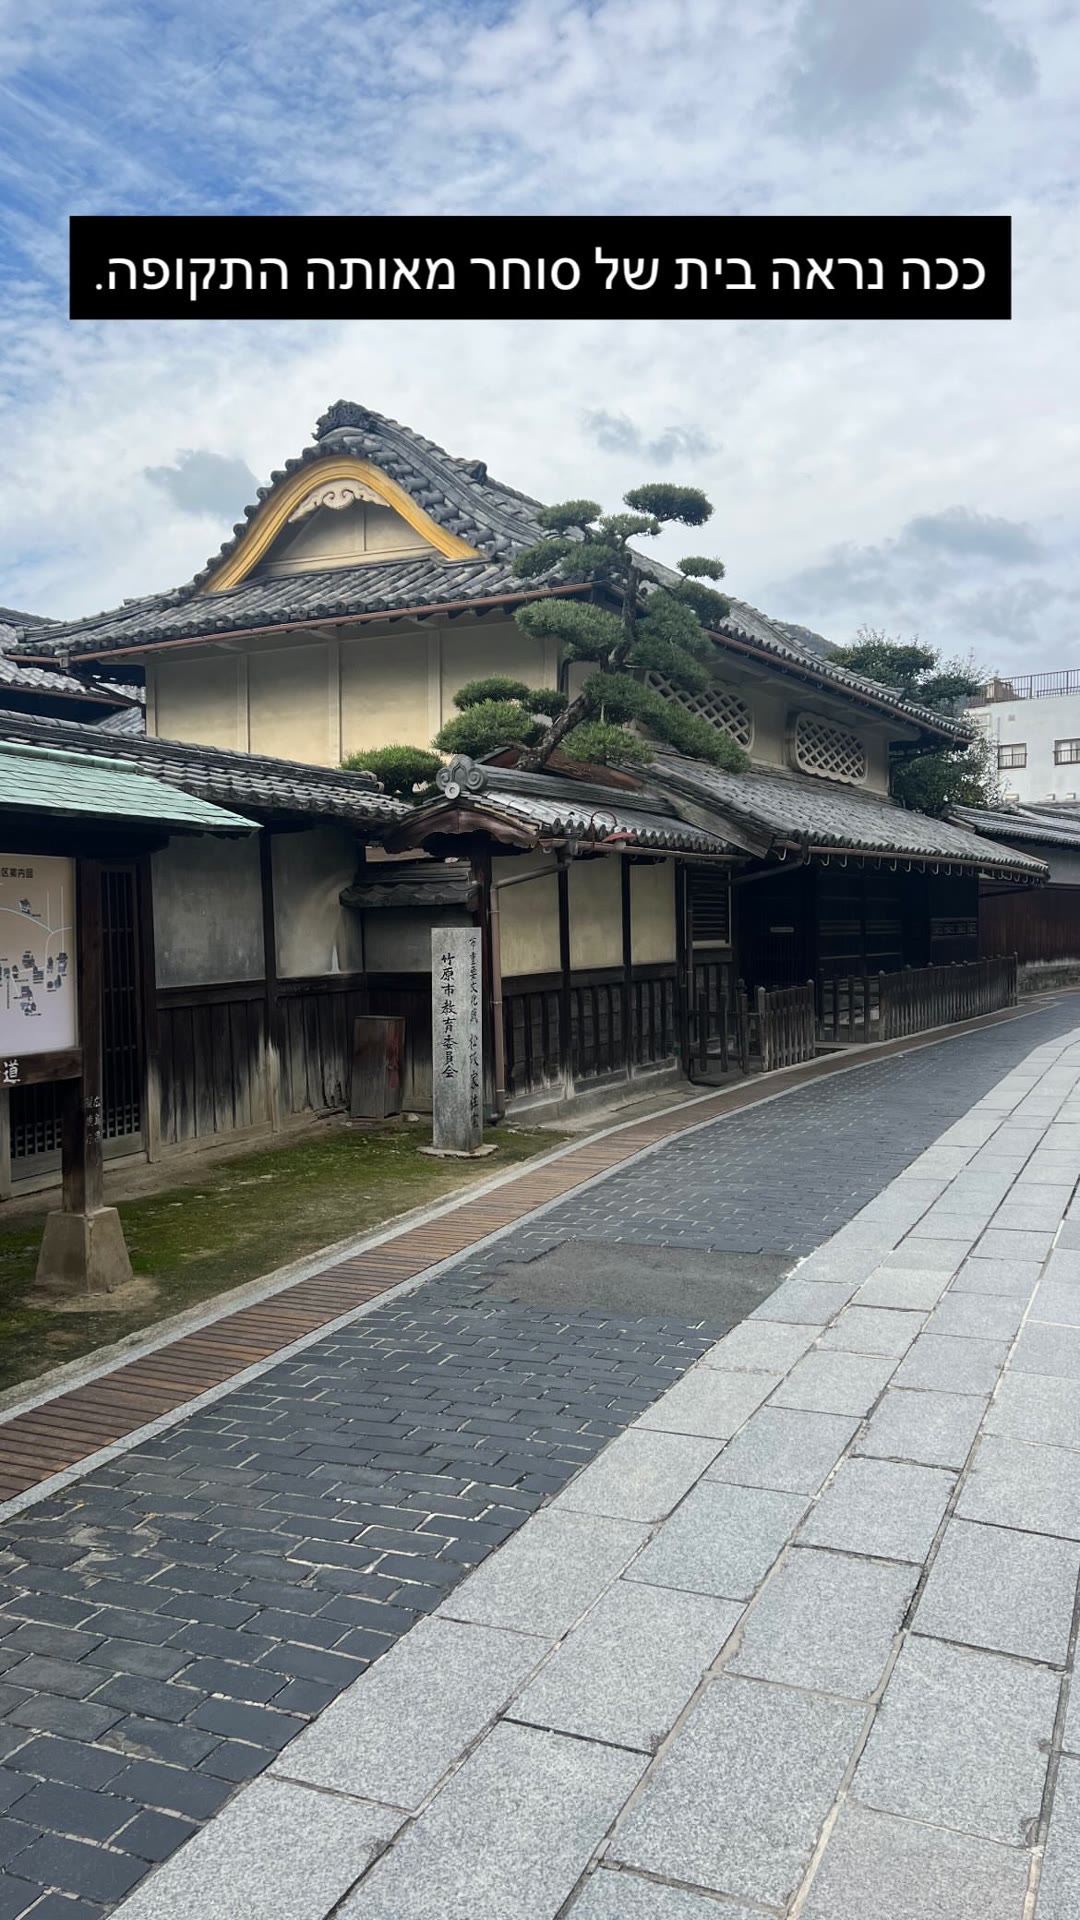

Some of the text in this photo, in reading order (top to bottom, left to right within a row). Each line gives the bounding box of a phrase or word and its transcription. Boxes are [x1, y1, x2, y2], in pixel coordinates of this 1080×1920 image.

[440, 952, 458, 1079] 竹原市教育委員会
[3, 1059, 20, 1084] 道
